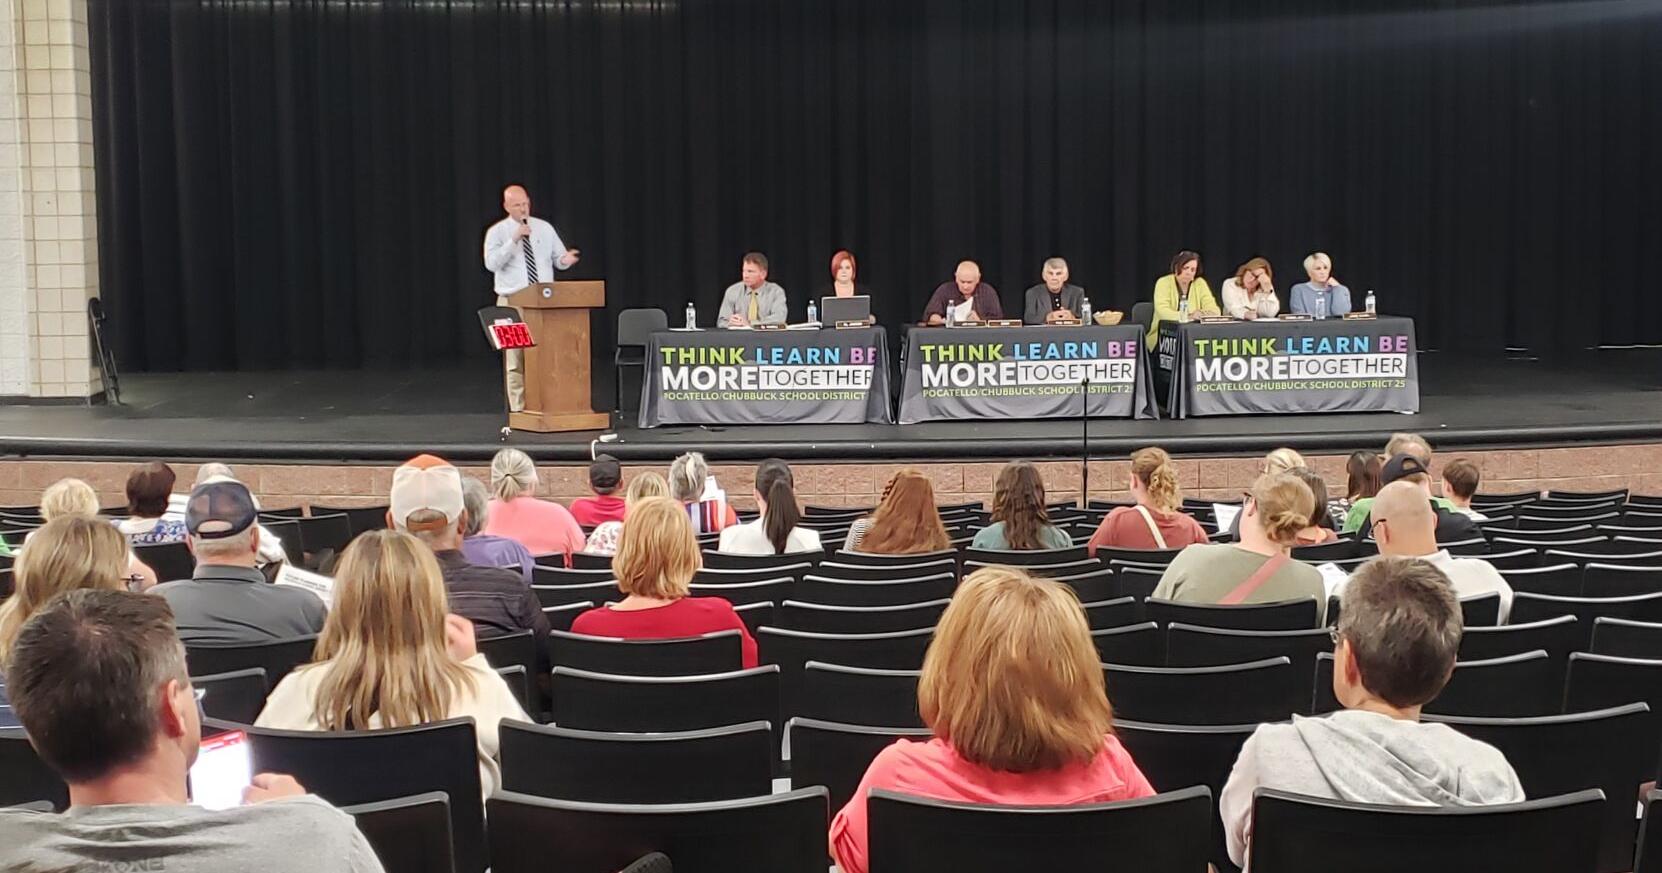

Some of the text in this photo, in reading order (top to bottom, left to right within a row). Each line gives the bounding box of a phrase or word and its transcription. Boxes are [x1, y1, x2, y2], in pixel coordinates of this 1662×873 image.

[660, 347, 877, 365] THINK LEARN BE
[920, 340, 1137, 362] THINK LEARN BE
[1194, 335, 1409, 357] THINK LEARN BE
[661, 365, 758, 391] MORE
[921, 362, 1133, 388] MORE TOGETHER
[1194, 356, 1289, 382] MORE
[1292, 357, 1404, 376] TOGETHER
[779, 391, 821, 400] SCHOOL
[822, 391, 866, 400] DISTRICT
[1038, 385, 1080, 395] SCHOOL
[1309, 380, 1351, 390] SCHOOL
[1351, 379, 1393, 389] DISTRICT
[1394, 379, 1406, 388] 25
